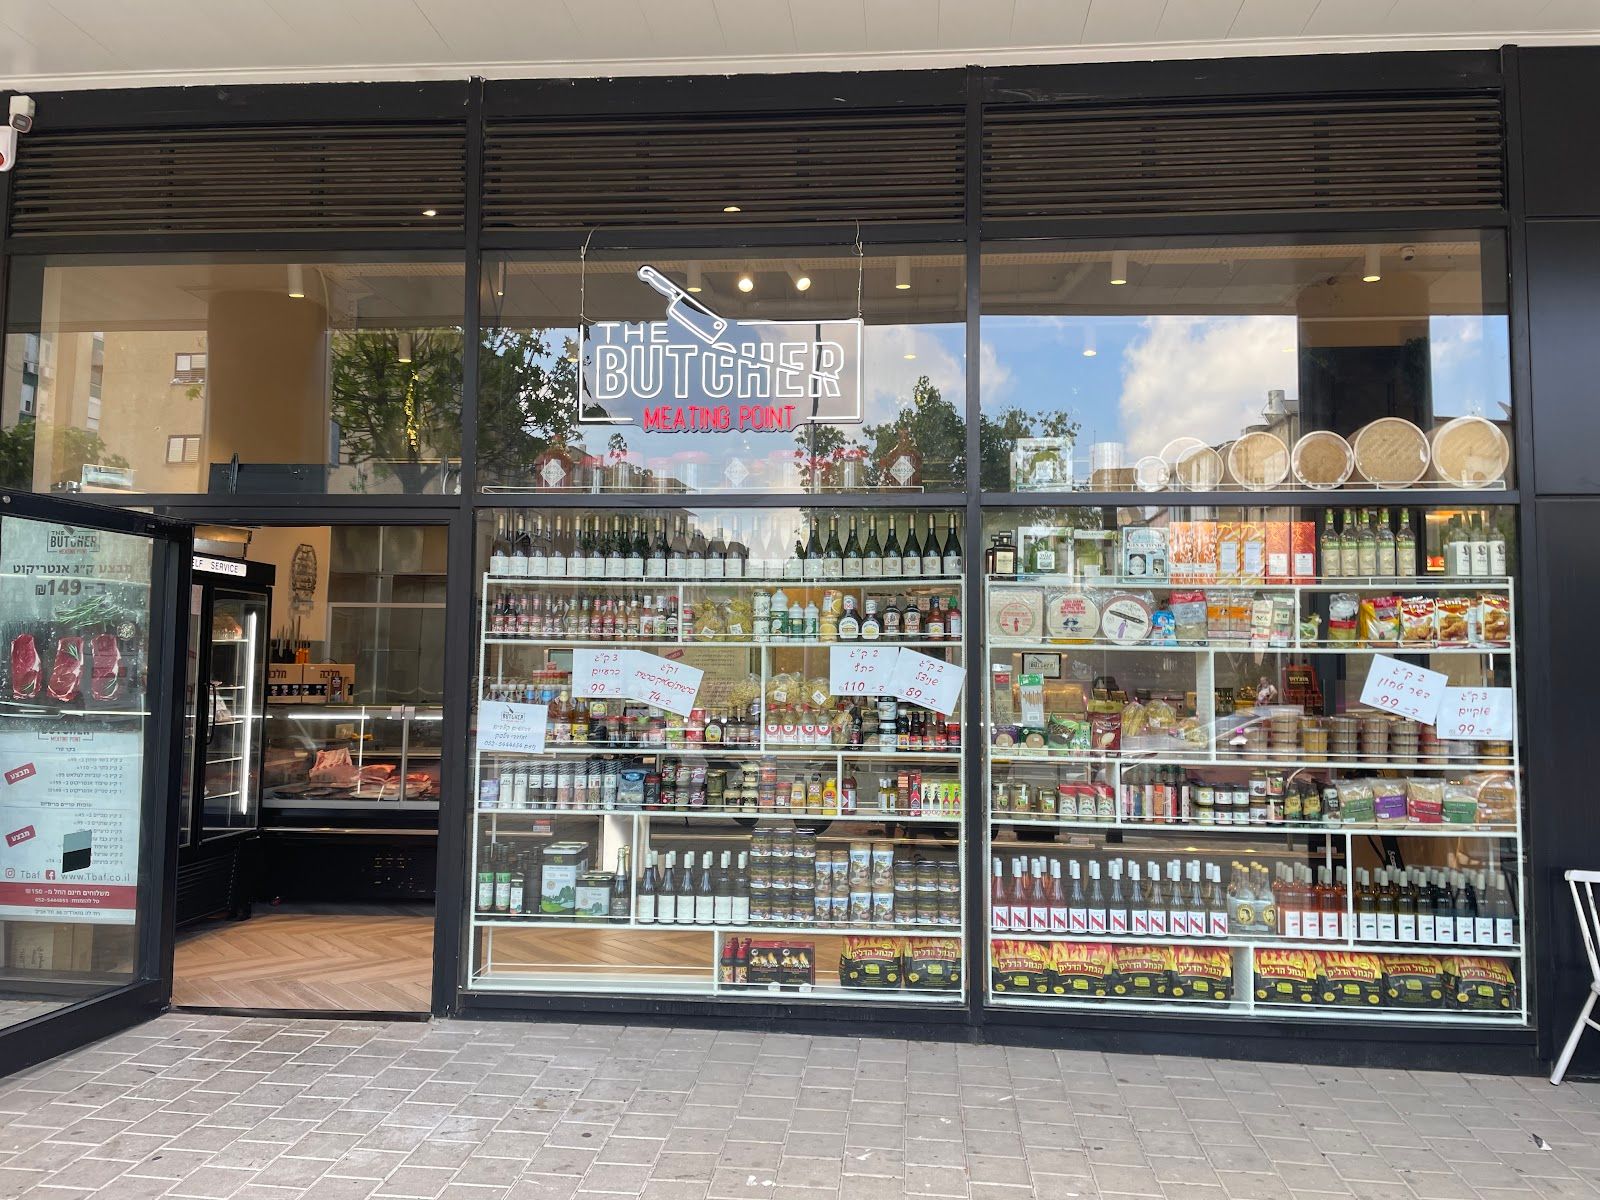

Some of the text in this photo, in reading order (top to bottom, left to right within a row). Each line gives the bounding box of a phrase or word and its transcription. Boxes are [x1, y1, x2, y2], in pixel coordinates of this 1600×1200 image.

[597, 323, 669, 343] THE
[596, 342, 845, 398] BUTCHER
[643, 405, 796, 430] MEATING POINT
[50, 536, 97, 548] BUTCHER
[13, 563, 70, 575] אנטריקוט
[210, 561, 239, 573] SERVICE
[613, 654, 618, 662] 3
[873, 649, 879, 658] 2
[269, 669, 287, 679] מלכ
[936, 665, 944, 673] 2
[1417, 674, 1425, 682] 2
[590, 683, 606, 694] 99
[844, 681, 865, 692] 110
[905, 687, 922, 699] 89
[1481, 692, 1488, 700] 3
[1380, 695, 1399, 707] 99
[1458, 724, 1475, 735] 99
[10, 768, 30, 780] מבצע
[11, 830, 30, 842] מבצע
[20, 870, 41, 879] Tbaf
[61, 872, 130, 882] www.Tbaf.co.il
